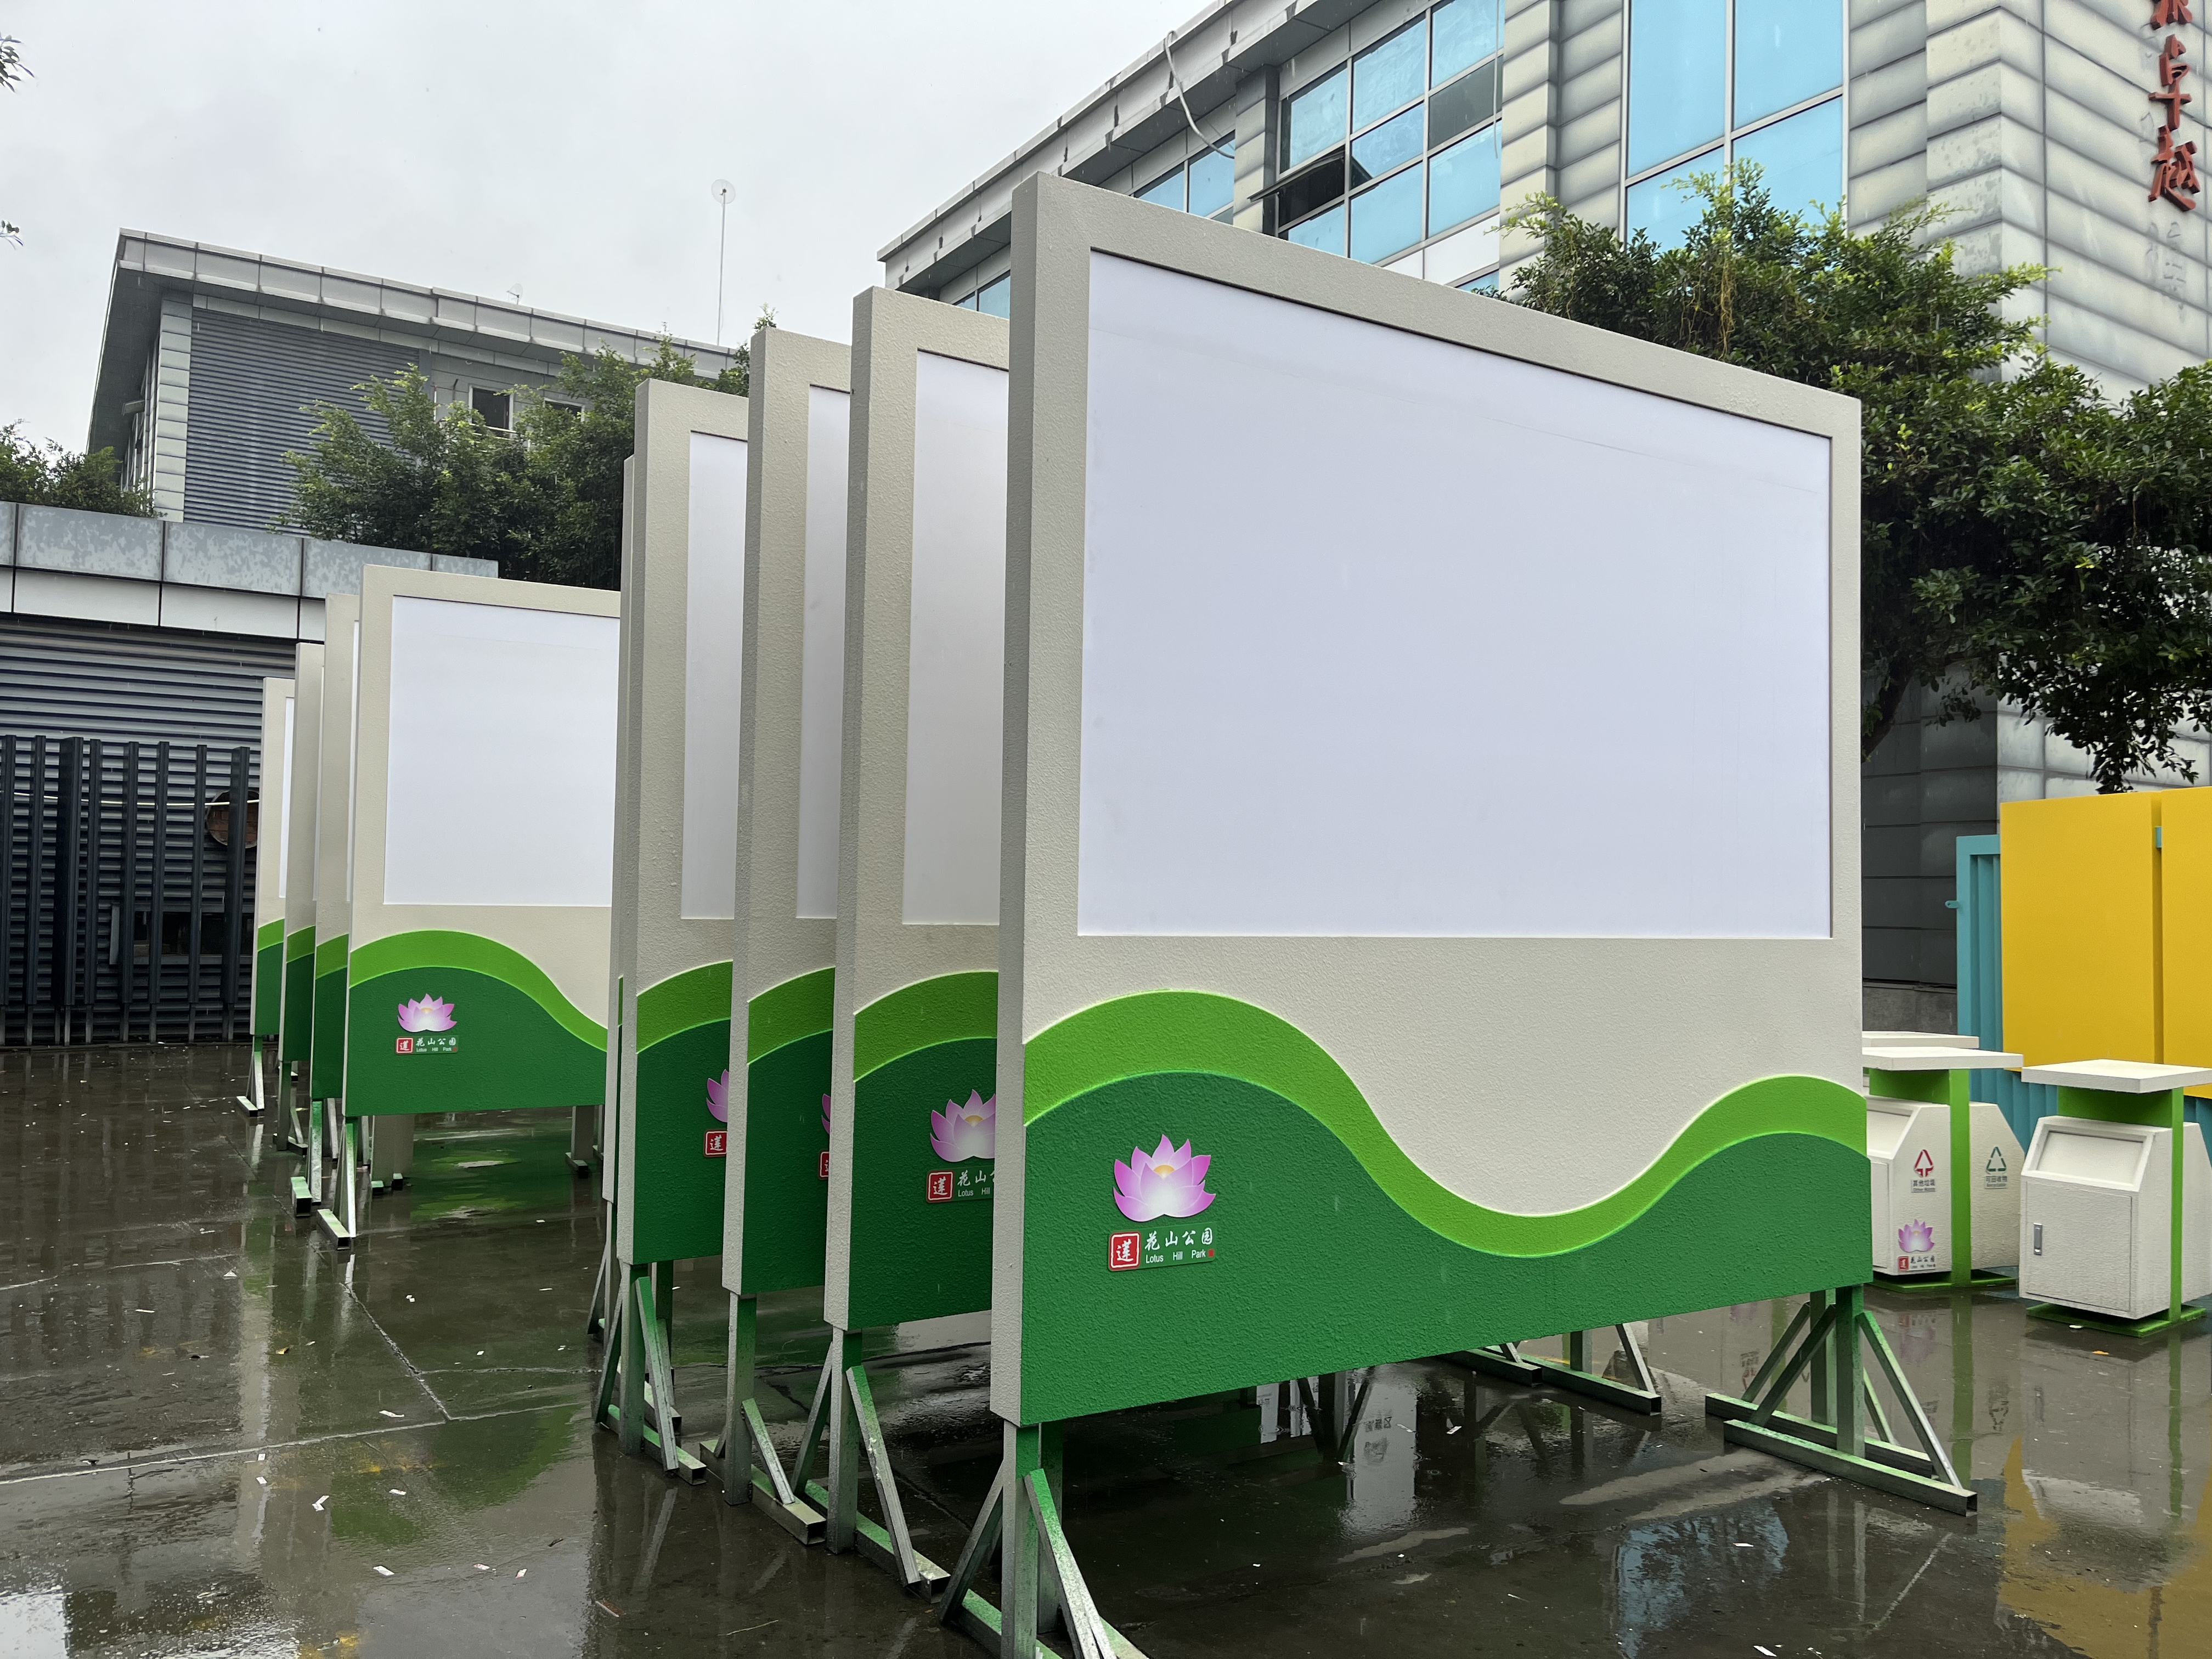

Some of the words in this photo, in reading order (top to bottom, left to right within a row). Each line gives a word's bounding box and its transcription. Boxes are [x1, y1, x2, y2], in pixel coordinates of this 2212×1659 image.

[958, 1189, 974, 1197] Lotus
[981, 1187, 991, 1195] Hill
[1146, 1254, 1164, 1263] Lotus
[1172, 1251, 1183, 1261] Hill
[1191, 1249, 1206, 1259] Park
